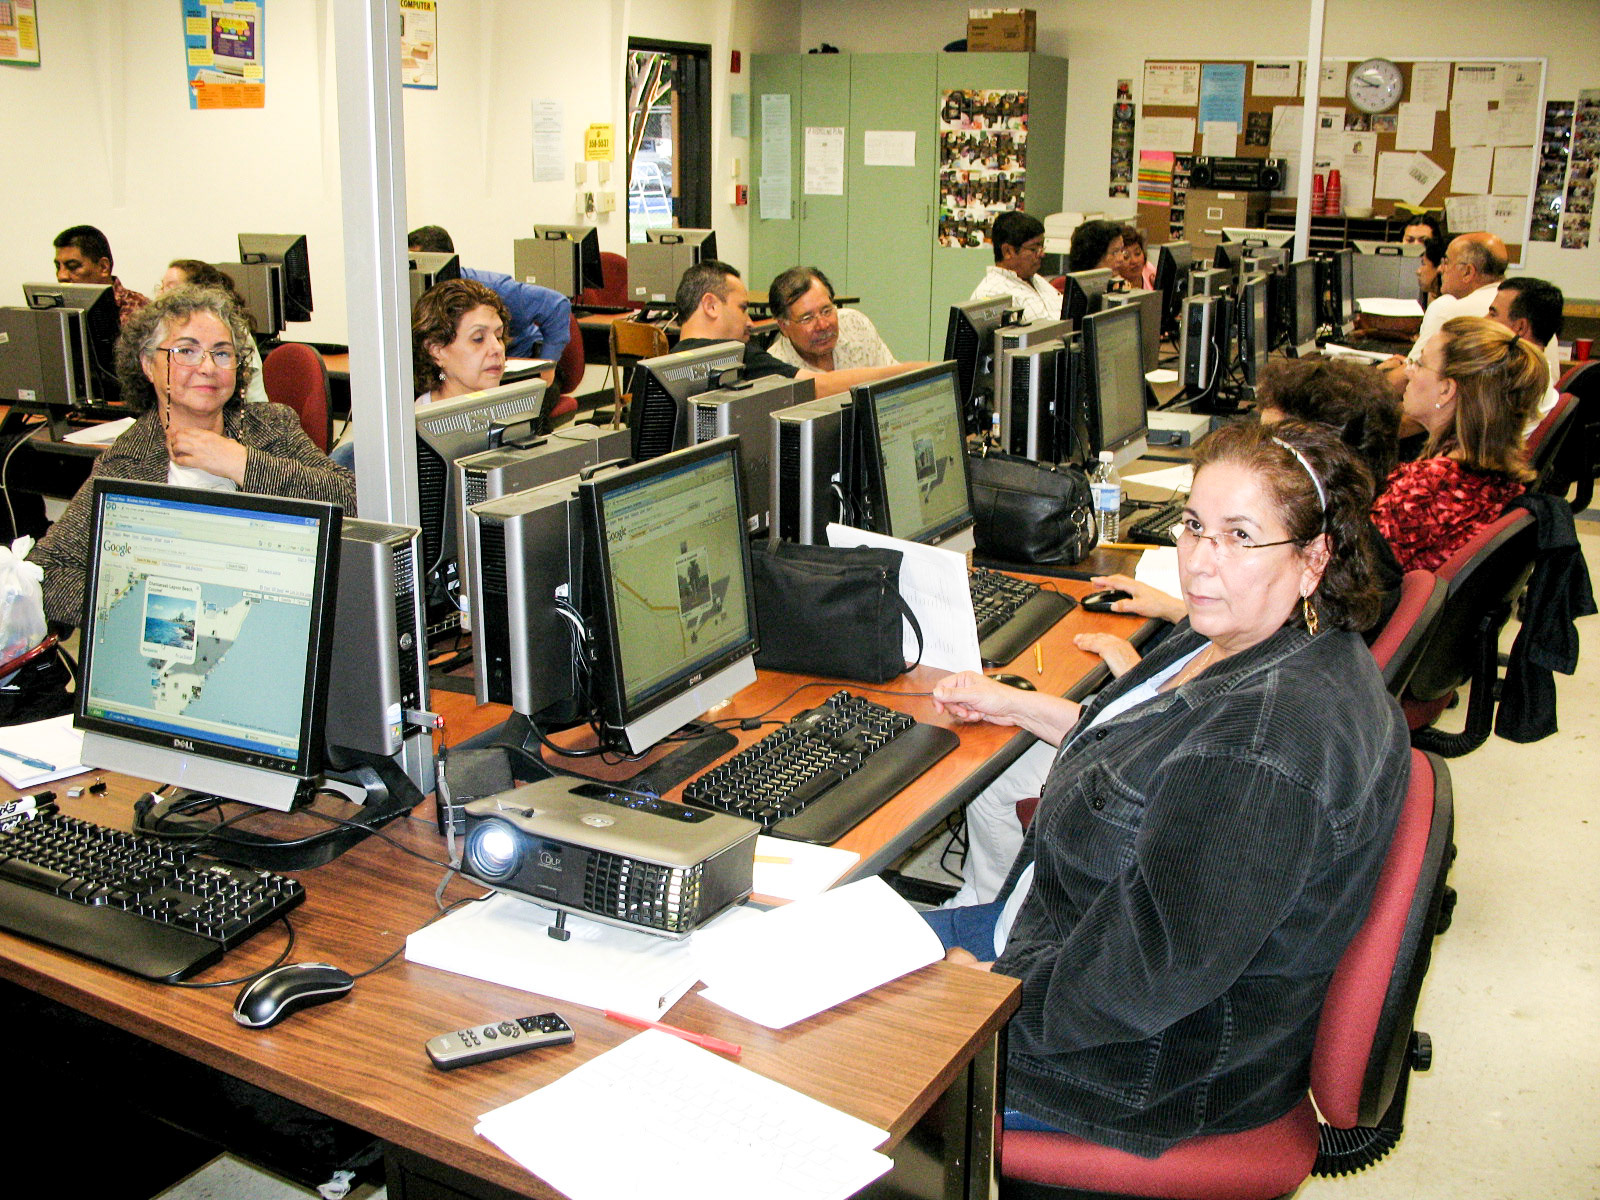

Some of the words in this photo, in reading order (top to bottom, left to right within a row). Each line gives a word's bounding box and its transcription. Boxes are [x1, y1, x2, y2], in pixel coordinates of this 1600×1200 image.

[400, 0, 431, 10] COMPUTER
[103, 539, 131, 557] Google
[173, 738, 194, 752] DELL
